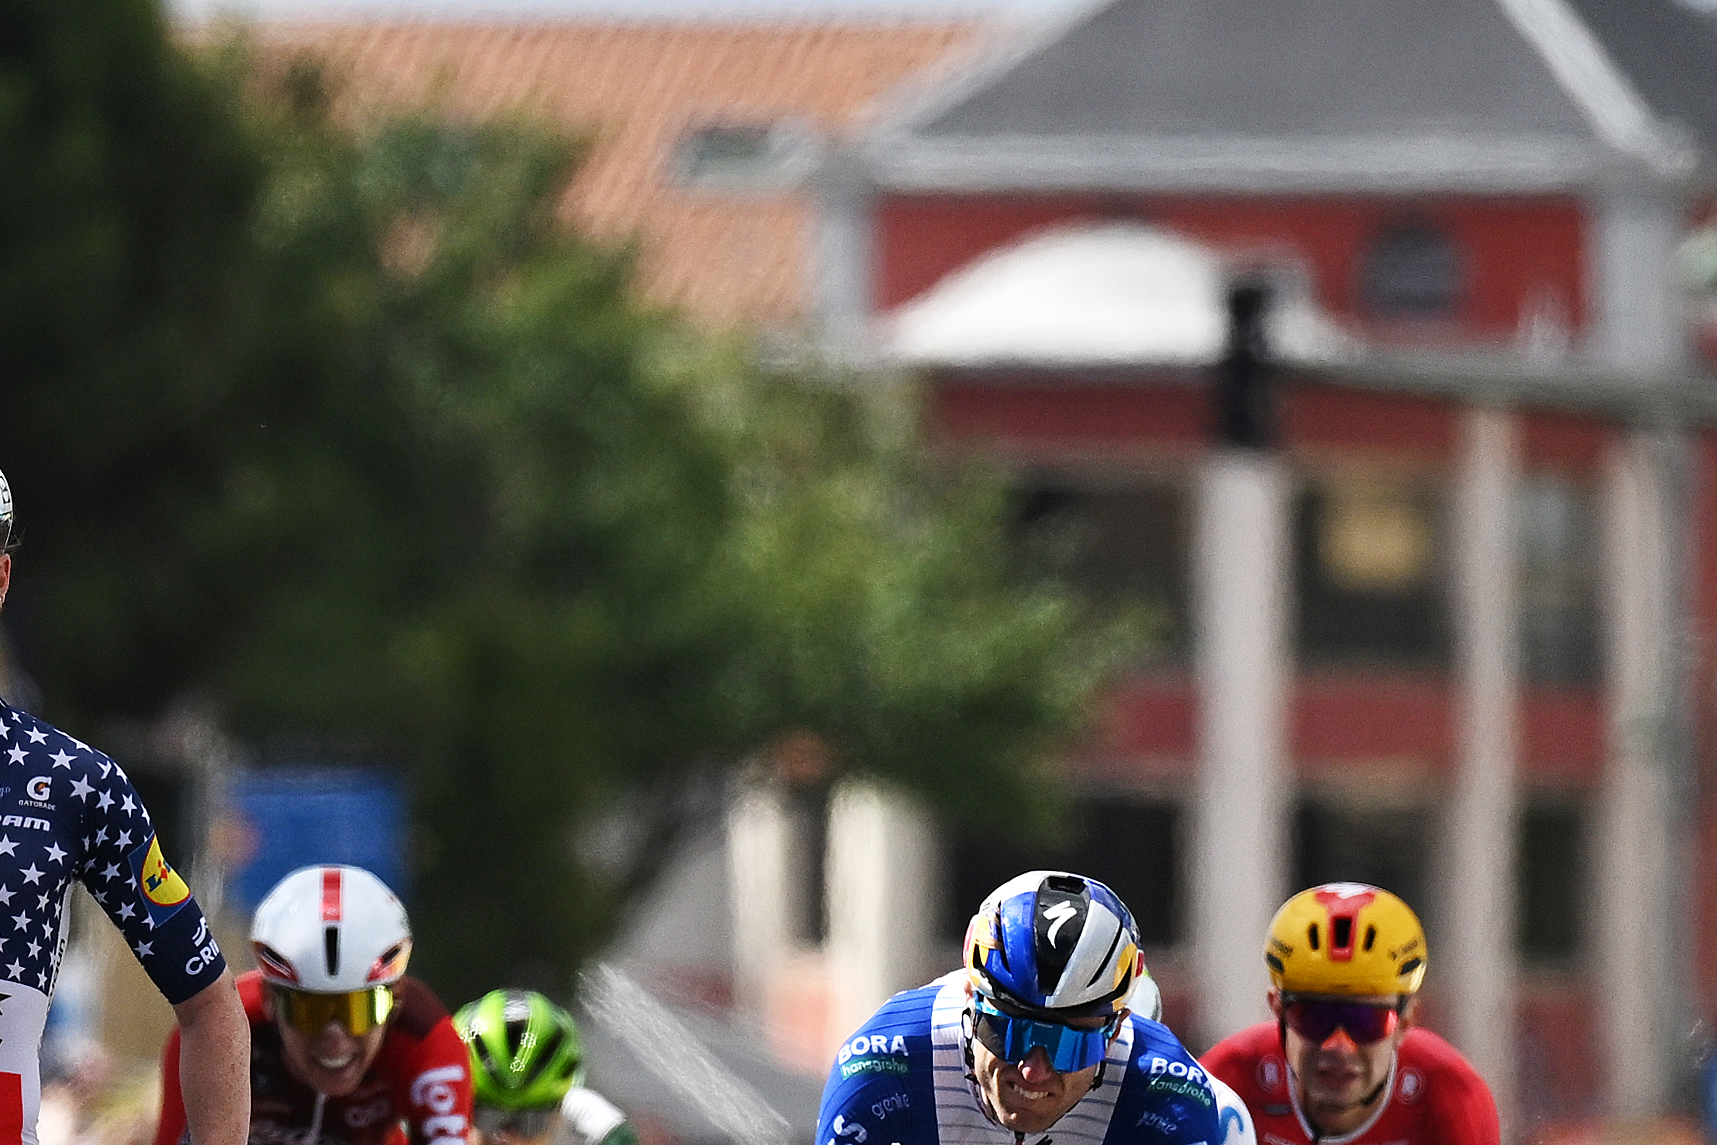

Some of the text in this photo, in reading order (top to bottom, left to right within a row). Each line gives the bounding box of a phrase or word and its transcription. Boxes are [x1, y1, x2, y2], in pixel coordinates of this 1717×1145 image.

[18, 799, 57, 811] GATORADE
[185, 938, 220, 976] CRI
[838, 1035, 909, 1065] BORA
[841, 1057, 908, 1078] hansgrohe
[1150, 1057, 1216, 1099] BORA
